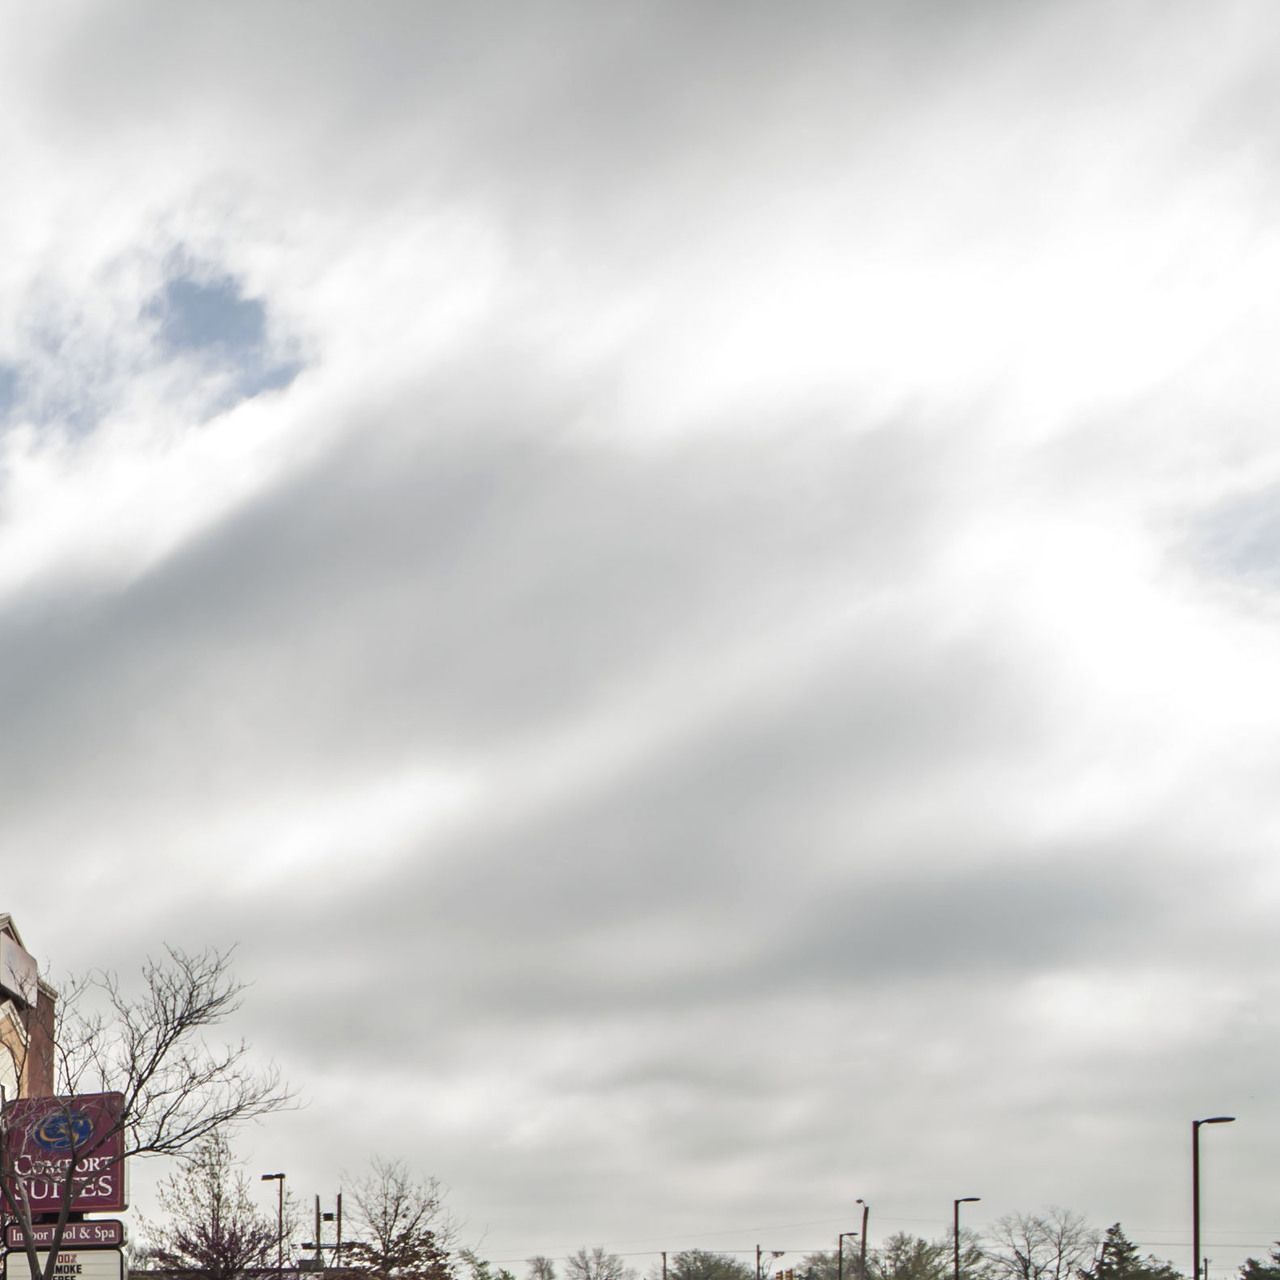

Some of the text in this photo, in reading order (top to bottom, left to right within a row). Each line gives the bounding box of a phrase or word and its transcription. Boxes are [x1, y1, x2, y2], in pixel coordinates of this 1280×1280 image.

[14, 1175, 113, 1200] SUIES
[12, 1229, 49, 1241] Inoor
[79, 1227, 91, 1240] &
[95, 1226, 115, 1241] Spa
[55, 1264, 82, 1275] MOKE
